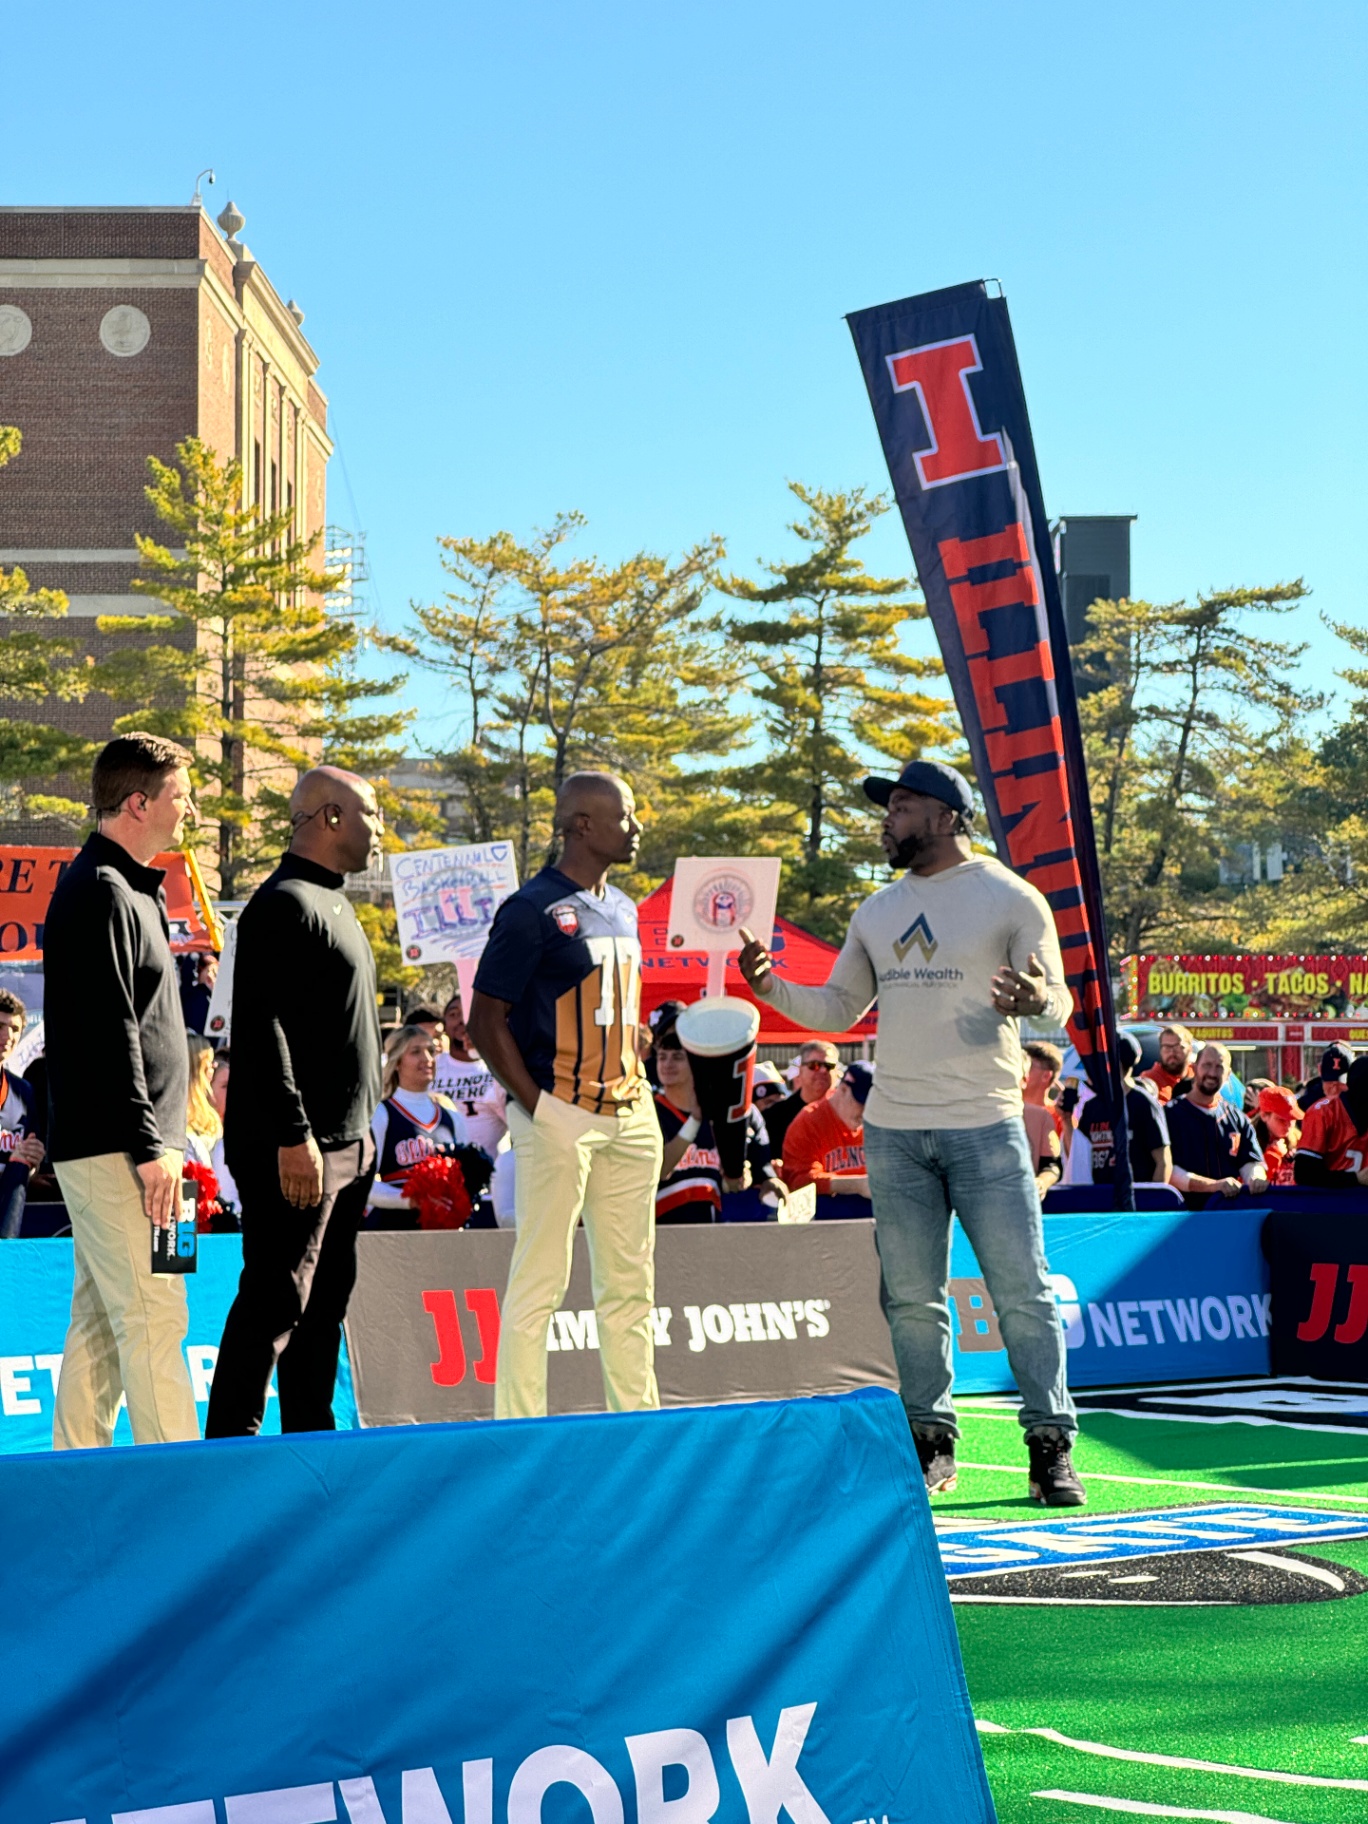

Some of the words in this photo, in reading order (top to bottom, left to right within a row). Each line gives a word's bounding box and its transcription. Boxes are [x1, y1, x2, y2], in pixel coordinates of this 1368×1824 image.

[885, 333, 1008, 491] I
[914, 967, 964, 981] Wealth
[1148, 972, 1245, 995] BURRITOS
[1265, 972, 1329, 995] TACOS
[683, 1299, 830, 1352] JOHN'S
[1088, 1292, 1273, 1348] NETWORK
